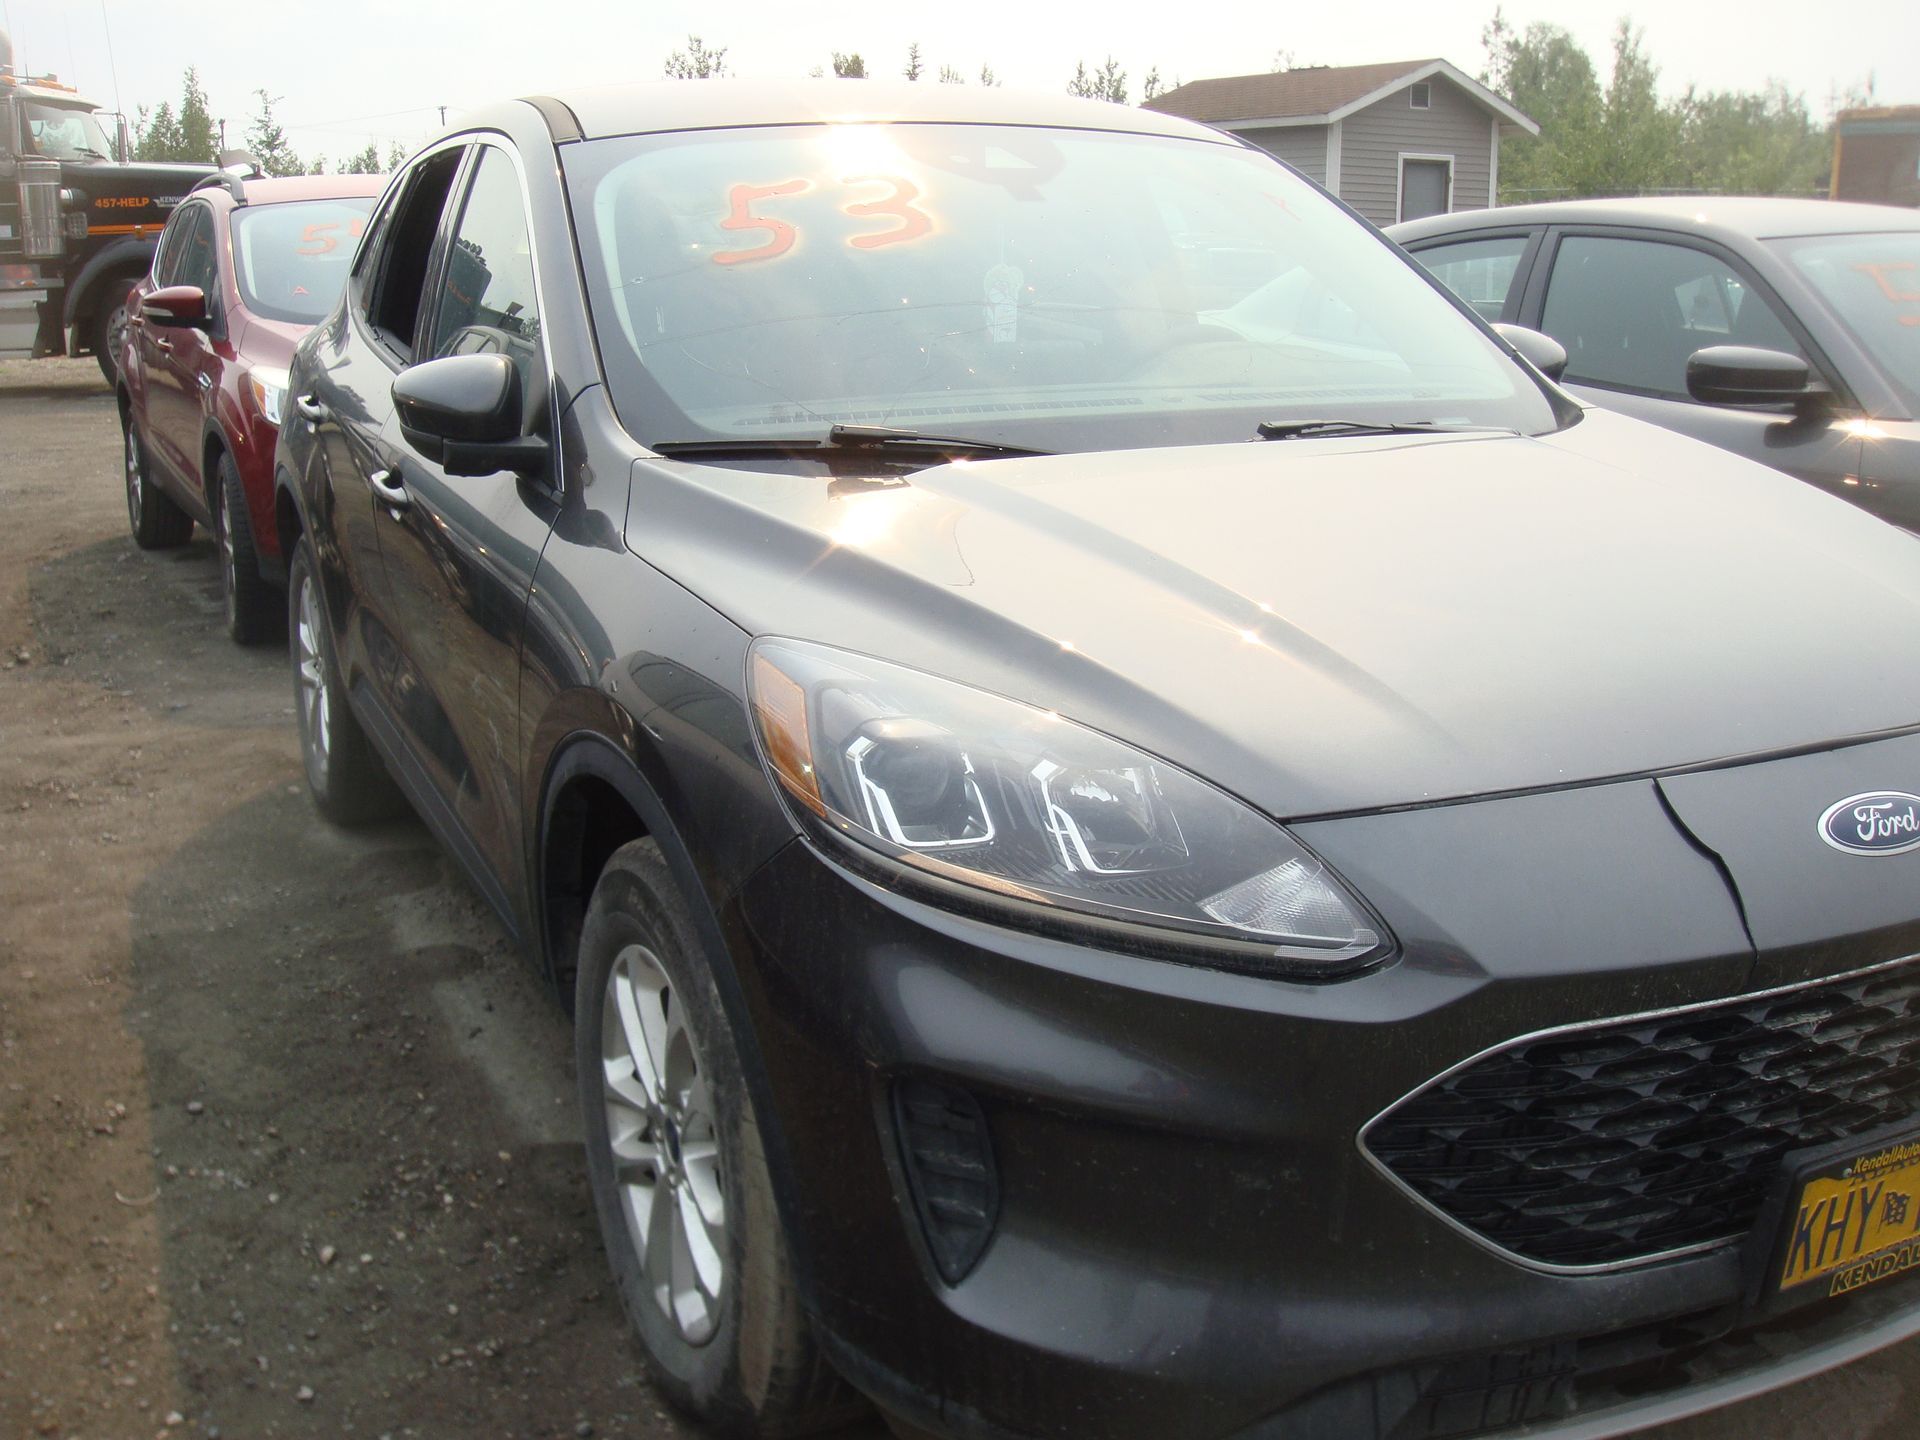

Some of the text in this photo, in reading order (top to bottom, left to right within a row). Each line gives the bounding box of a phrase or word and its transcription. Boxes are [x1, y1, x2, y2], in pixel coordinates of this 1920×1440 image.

[95, 197, 150, 208] 457-HELP
[712, 177, 934, 265] 53
[1853, 802, 1920, 842] Ford
[1785, 1181, 1884, 1279] KHY
